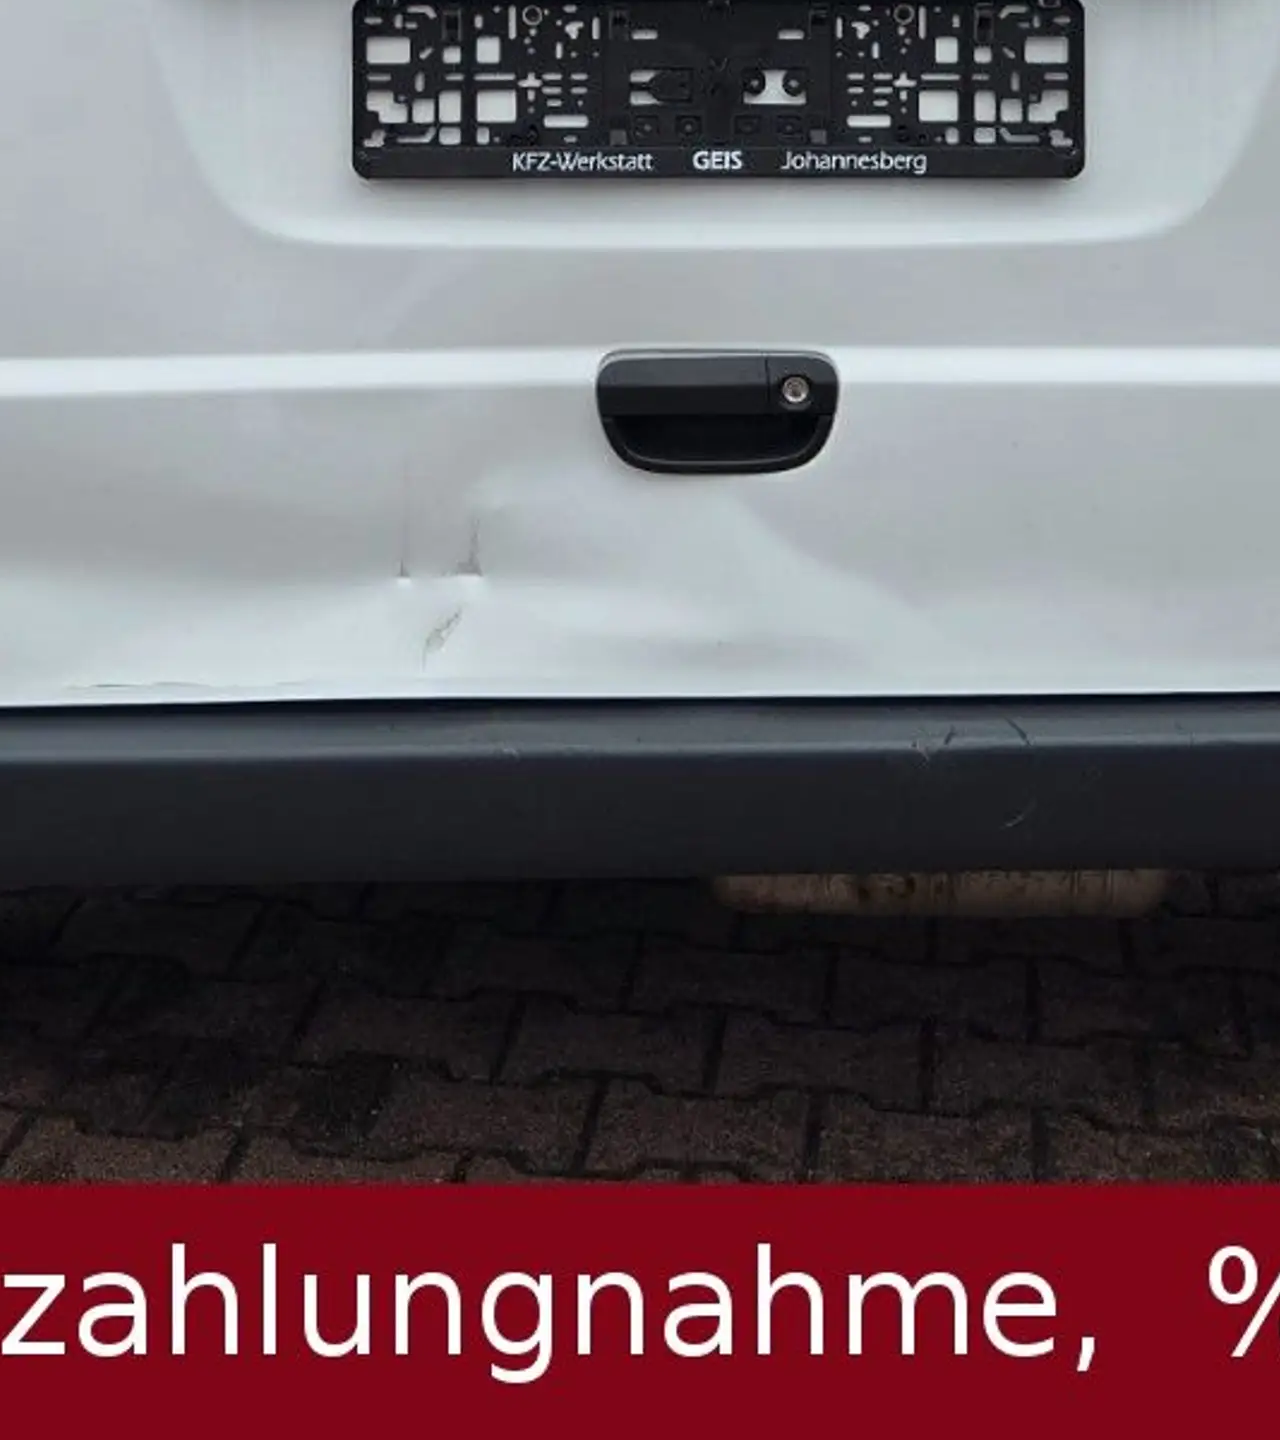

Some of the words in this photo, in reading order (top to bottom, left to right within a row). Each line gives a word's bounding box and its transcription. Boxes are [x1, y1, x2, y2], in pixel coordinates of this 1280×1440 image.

[512, 151, 654, 172] KFZ-Werkstatt
[692, 150, 742, 171] GEIS
[780, 150, 928, 175] Johannesberg
